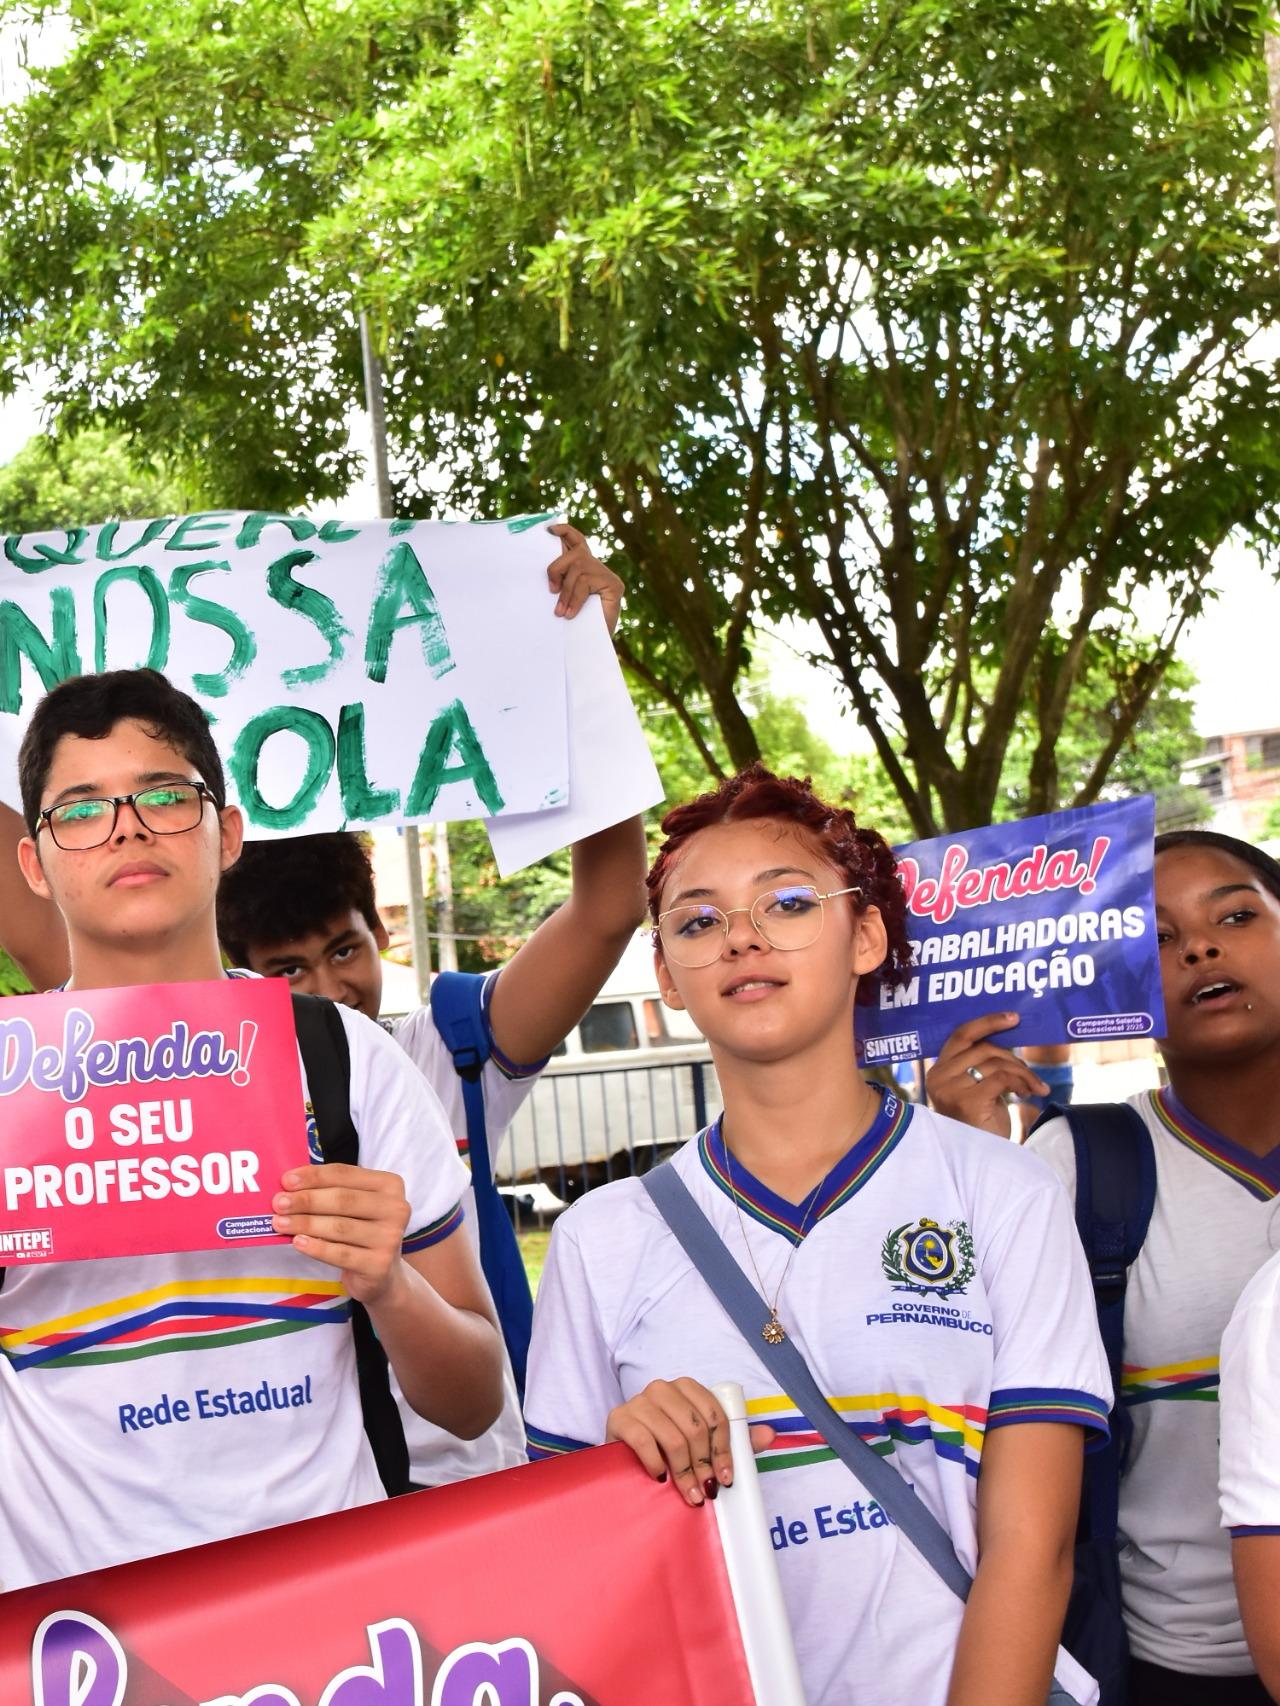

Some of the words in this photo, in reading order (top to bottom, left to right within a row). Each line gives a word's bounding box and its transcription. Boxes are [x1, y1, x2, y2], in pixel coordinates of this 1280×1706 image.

[202, 698, 505, 831] OLA
[892, 906, 1146, 969] RABALHADORAS
[880, 975, 920, 1011] EM
[927, 948, 1095, 1003] EDUCAÇÃO
[866, 1034, 919, 1058] SINTEPE
[64, 1107, 94, 1150] O
[109, 1098, 193, 1147] SEU
[4, 1150, 261, 1211] PROFESSOR
[225, 1220, 263, 1228] Campanha
[225, 1226, 272, 1235] Educacional
[866, 1312, 993, 1336] PERNAMBUCO
[892, 1303, 960, 1318] GOVERNO
[118, 1394, 190, 1433] Rede
[195, 1374, 312, 1419] Estadual
[770, 1516, 809, 1551] de
[814, 1500, 897, 1539] Esta
